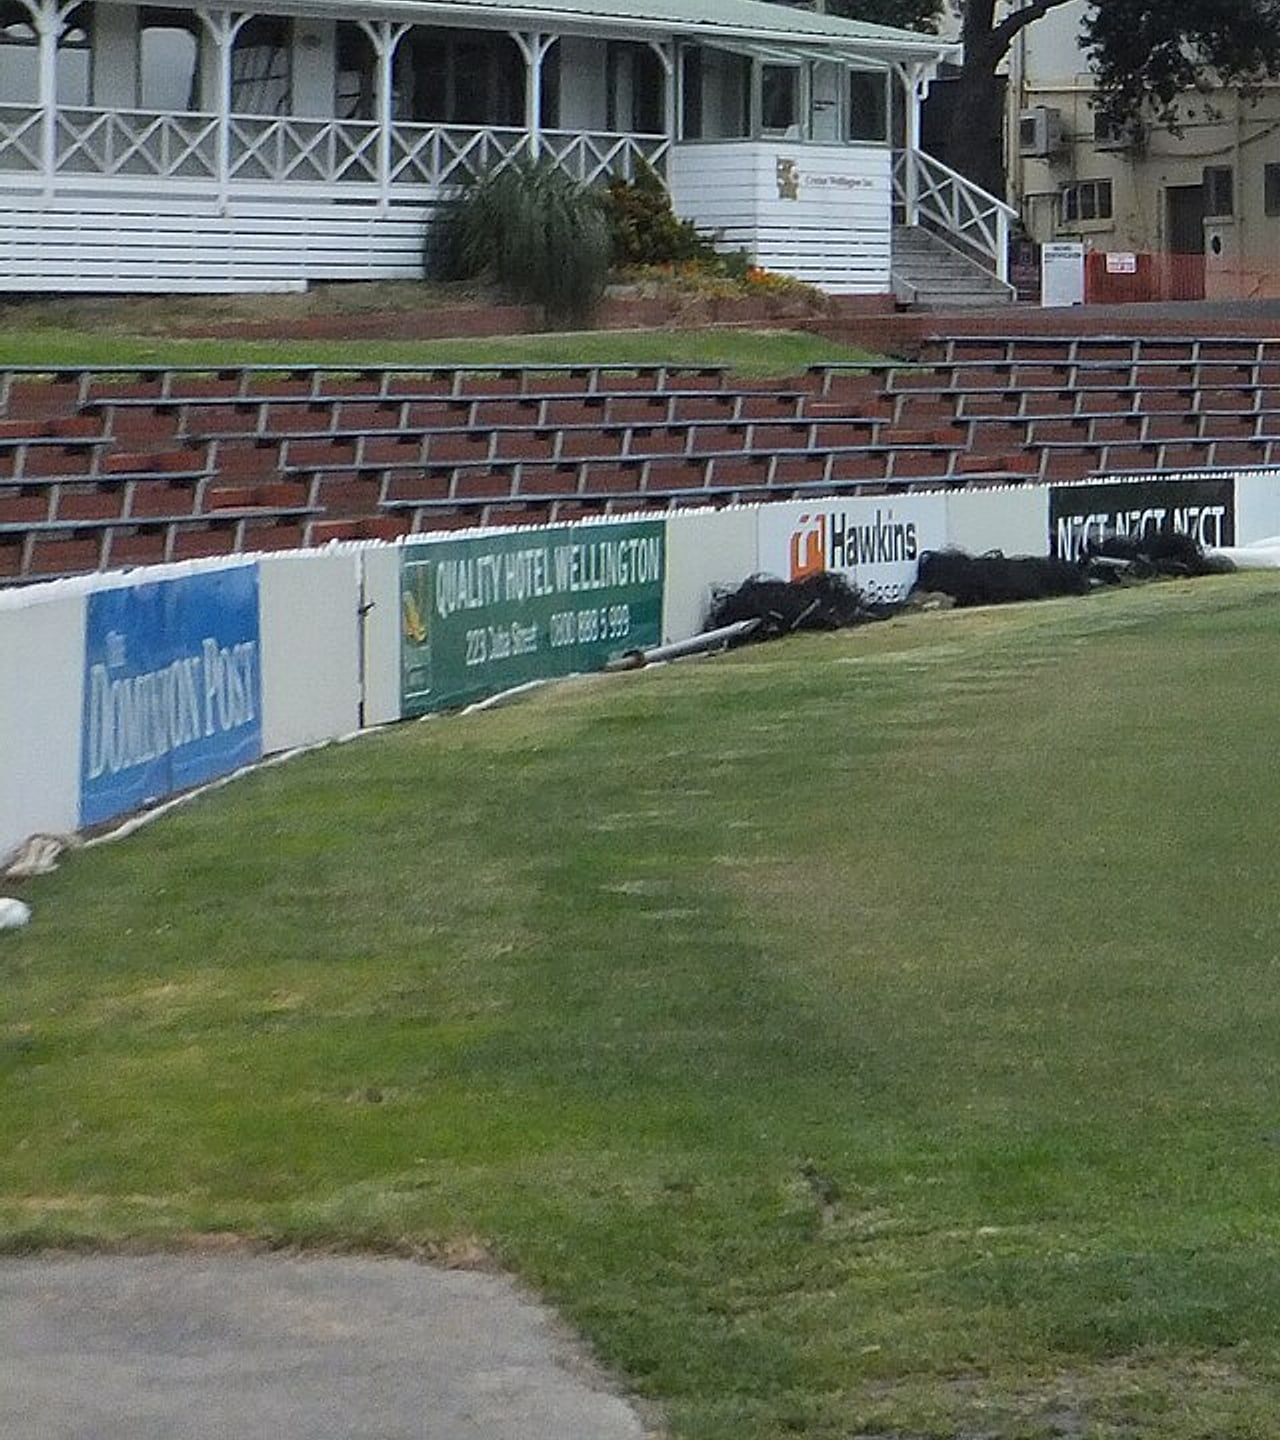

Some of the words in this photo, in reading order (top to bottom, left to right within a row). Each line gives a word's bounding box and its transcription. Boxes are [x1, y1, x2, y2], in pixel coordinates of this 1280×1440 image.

[830, 510, 917, 568] Hawkins
[436, 553, 502, 619] QUALITY
[505, 546, 552, 602] HOTEL
[554, 536, 661, 593] WELLINGTON
